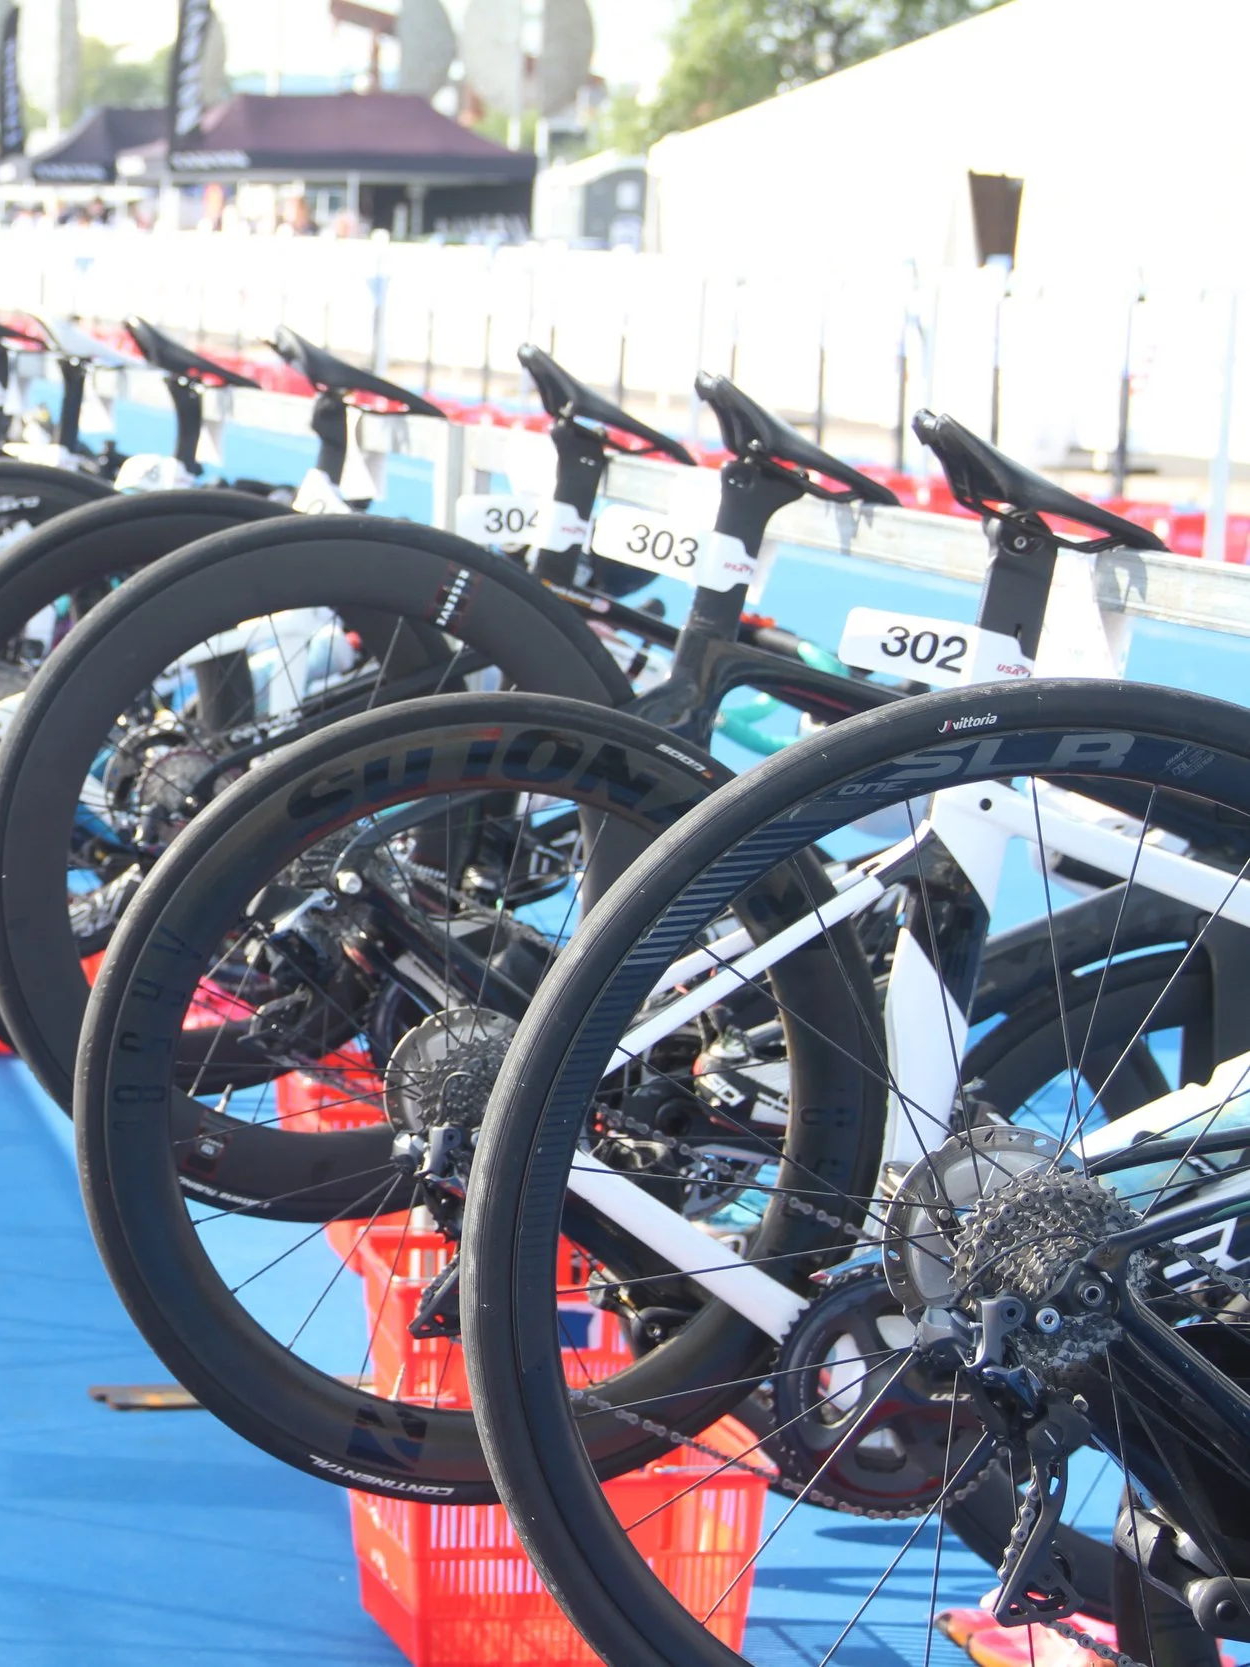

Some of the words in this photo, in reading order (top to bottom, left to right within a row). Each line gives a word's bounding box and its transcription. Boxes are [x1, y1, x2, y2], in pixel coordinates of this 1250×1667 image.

[626, 524, 699, 567] 303
[436, 569, 470, 627] RESERVE
[881, 626, 967, 674] 302
[952, 712, 998, 730] vittoria
[884, 732, 1135, 780] SLR
[310, 1454, 455, 1497] CONTINENTAL
